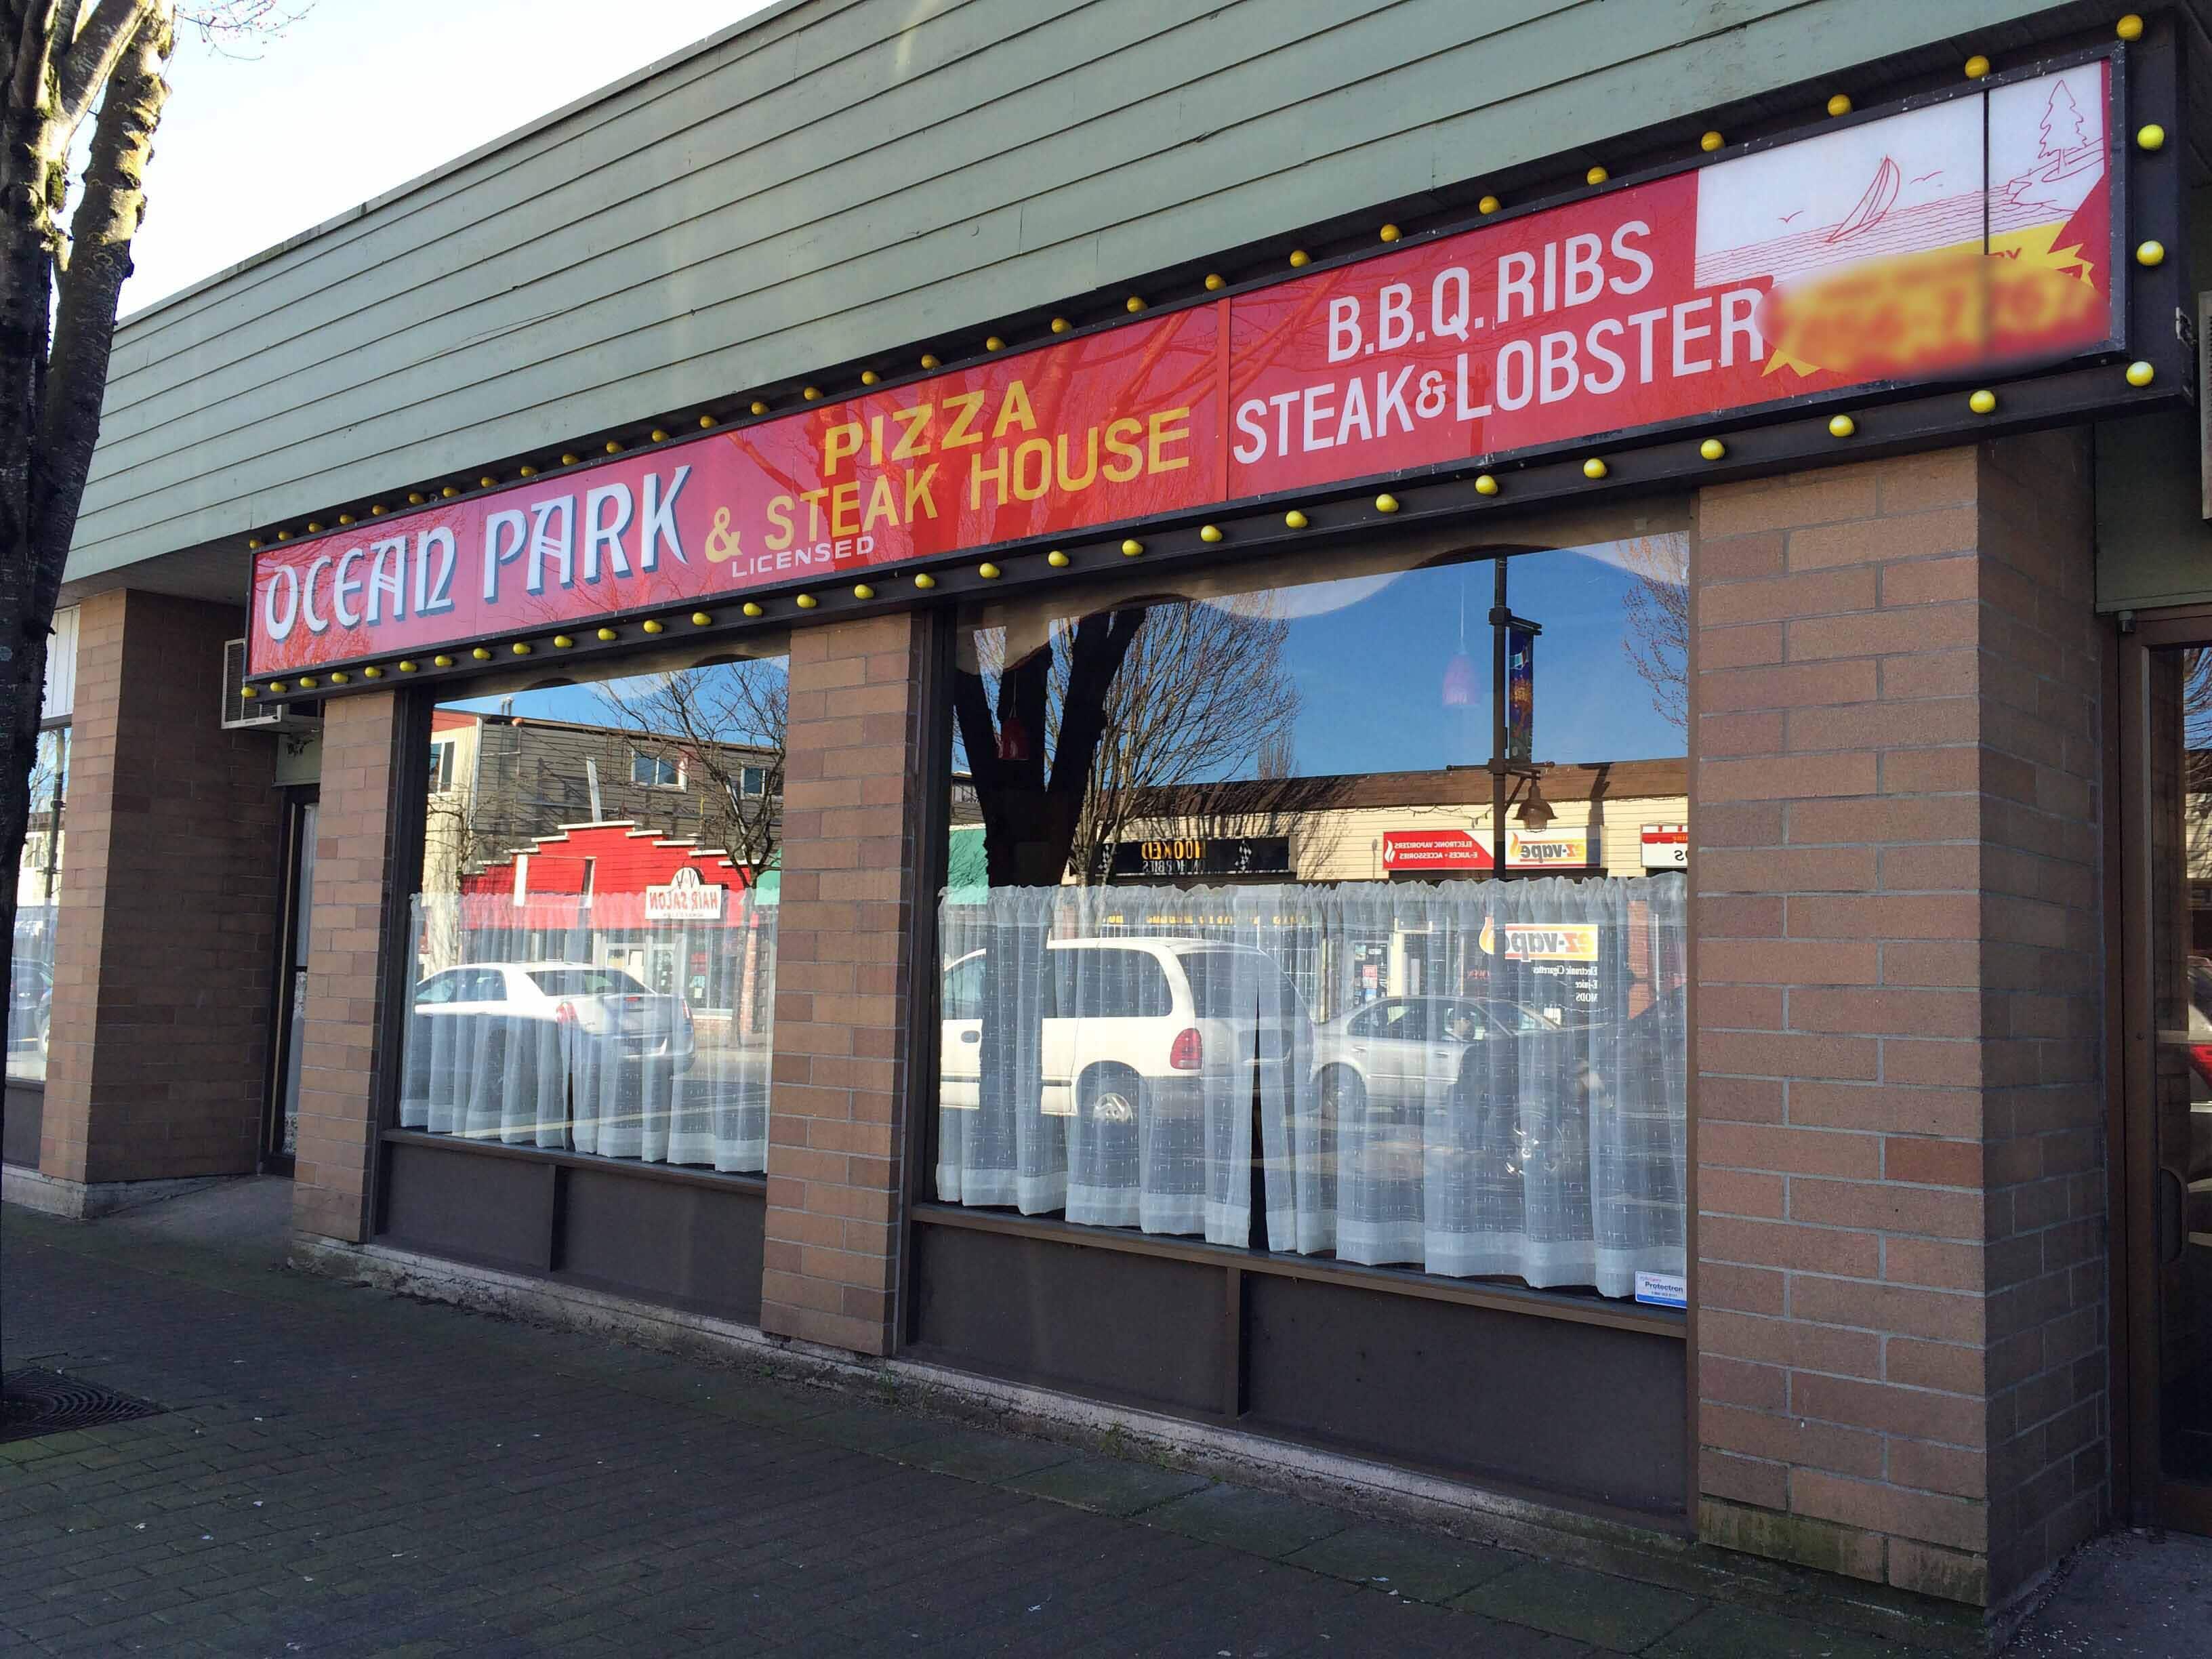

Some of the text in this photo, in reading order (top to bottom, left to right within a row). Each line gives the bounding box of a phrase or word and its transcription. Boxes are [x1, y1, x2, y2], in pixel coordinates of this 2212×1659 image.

[1496, 221, 1654, 324] RIBS
[824, 380, 1036, 476] PIZZA
[1233, 365, 1415, 465] STEAK
[1415, 371, 1447, 420] &
[1456, 287, 1767, 422] LOBSTER
[704, 407, 1191, 563] & STEAK HOUSE
[265, 465, 691, 641] OCEAN PARK
[732, 535, 874, 578] LICENSED
